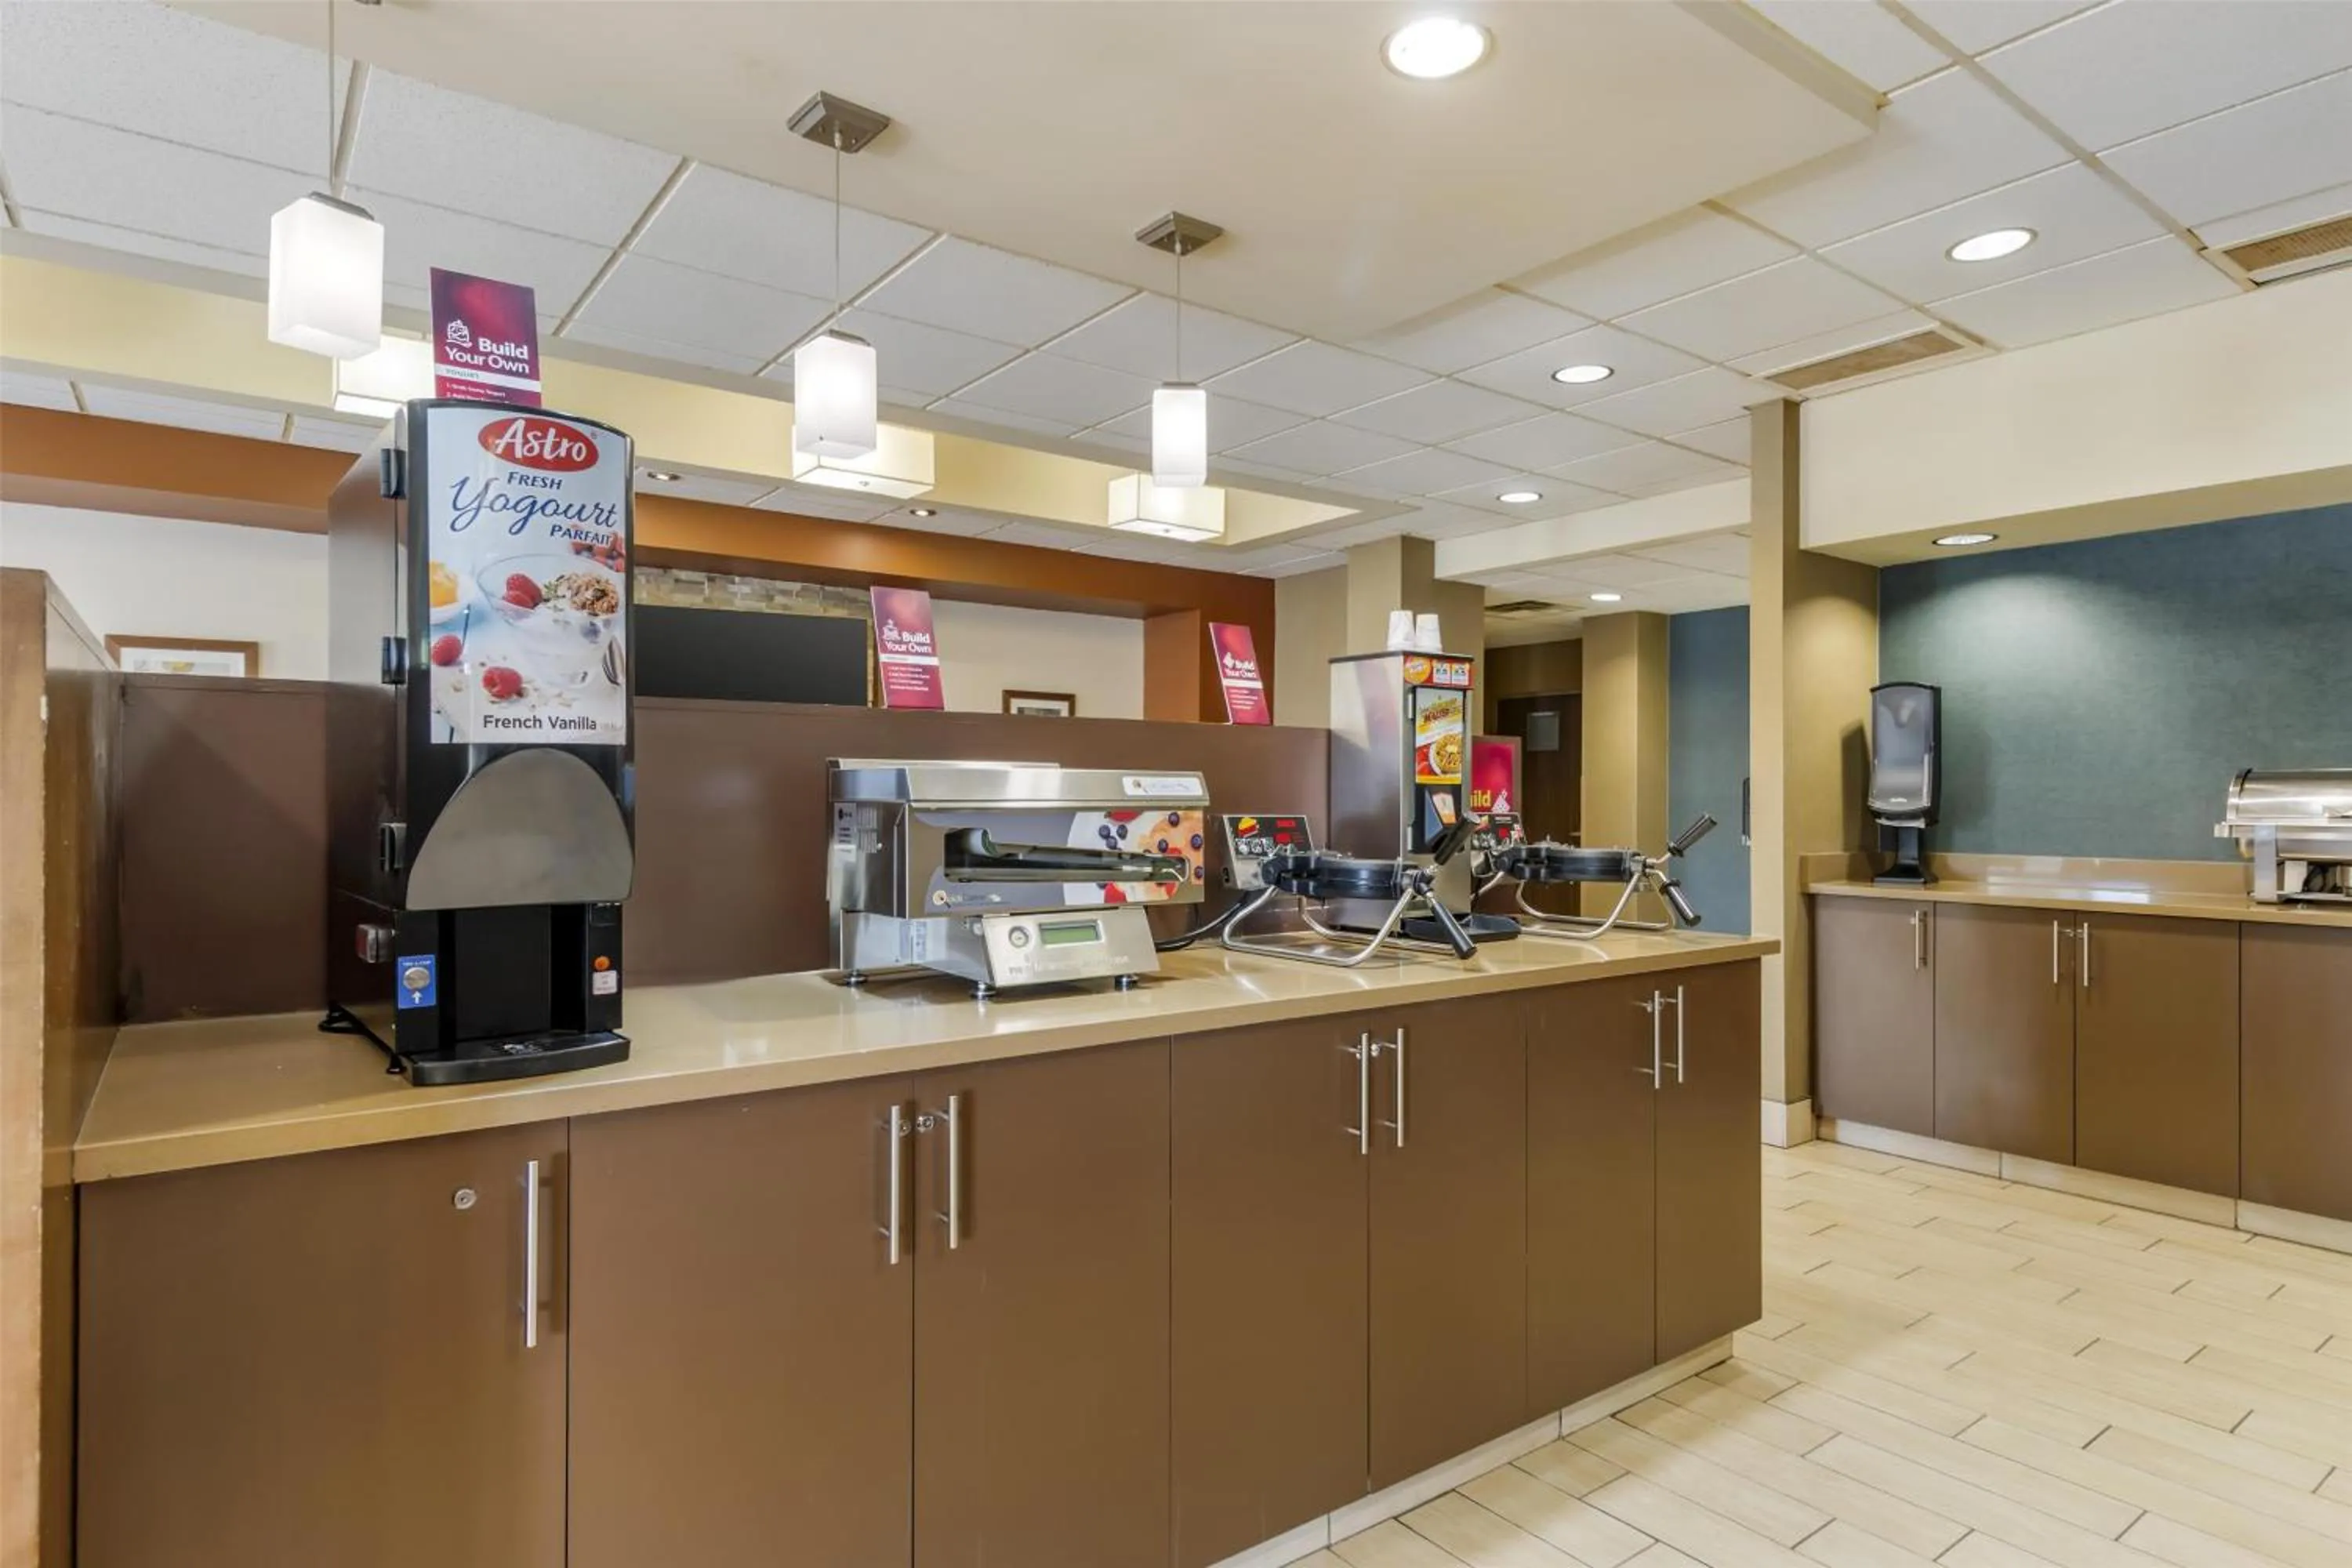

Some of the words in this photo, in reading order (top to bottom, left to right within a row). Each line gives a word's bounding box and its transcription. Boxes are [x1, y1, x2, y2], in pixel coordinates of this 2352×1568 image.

[478, 338, 528, 360] Build
[445, 345, 486, 365] Your
[488, 354, 529, 374] Own
[494, 418, 587, 462] Astro
[507, 471, 562, 490] FRESH
[449, 476, 618, 535] Yogourt
[550, 524, 613, 546] PARFAIT
[885, 641, 907, 652] Your
[909, 642, 931, 653] Own
[902, 632, 930, 644] Build
[483, 715, 543, 729] French
[548, 716, 597, 730] Vanilla
[1470, 789, 1491, 807] ild
